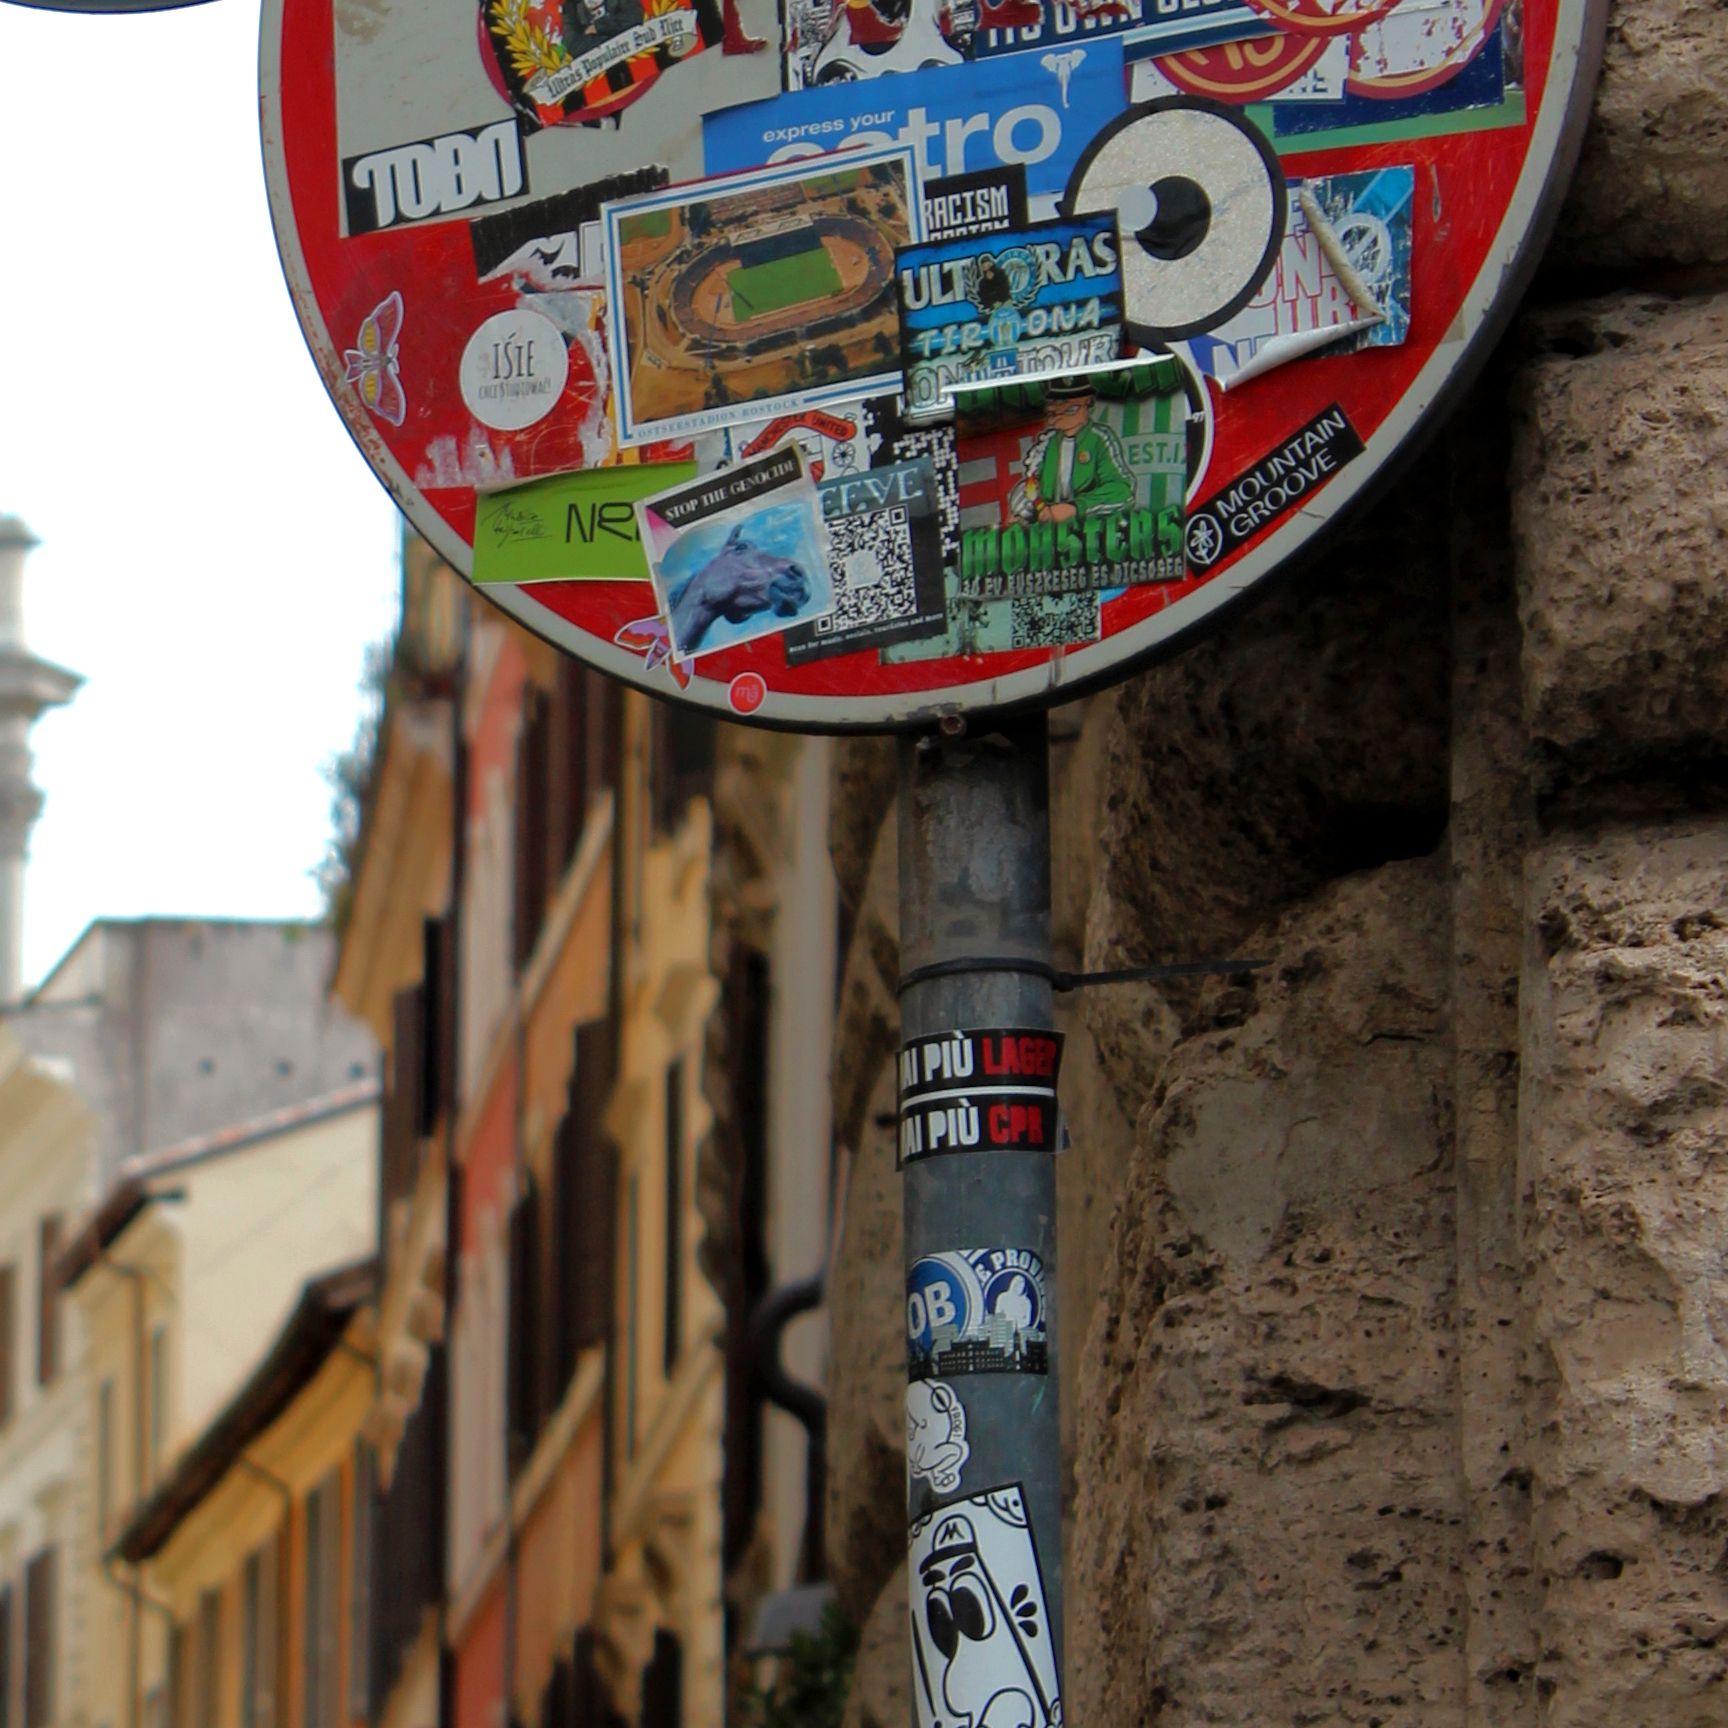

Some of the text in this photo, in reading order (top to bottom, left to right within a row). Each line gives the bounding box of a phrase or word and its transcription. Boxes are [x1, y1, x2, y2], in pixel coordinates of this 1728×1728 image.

[633, 27, 657, 49] Sud
[763, 109, 897, 144] express your
[923, 185, 1009, 230] RACISM
[638, 398, 800, 439] OSTSEESTADION ROSTOCK
[1217, 410, 1347, 520] MOUNTAIN
[665, 494, 699, 522] STOP
[701, 482, 729, 507] THE
[1229, 447, 1338, 539] GROOVE
[962, 506, 1182, 575] MONSTERS
[923, 1029, 974, 1081] PIÙ
[927, 1097, 980, 1150] PIÙ
[987, 1104, 1044, 1145] CPR
